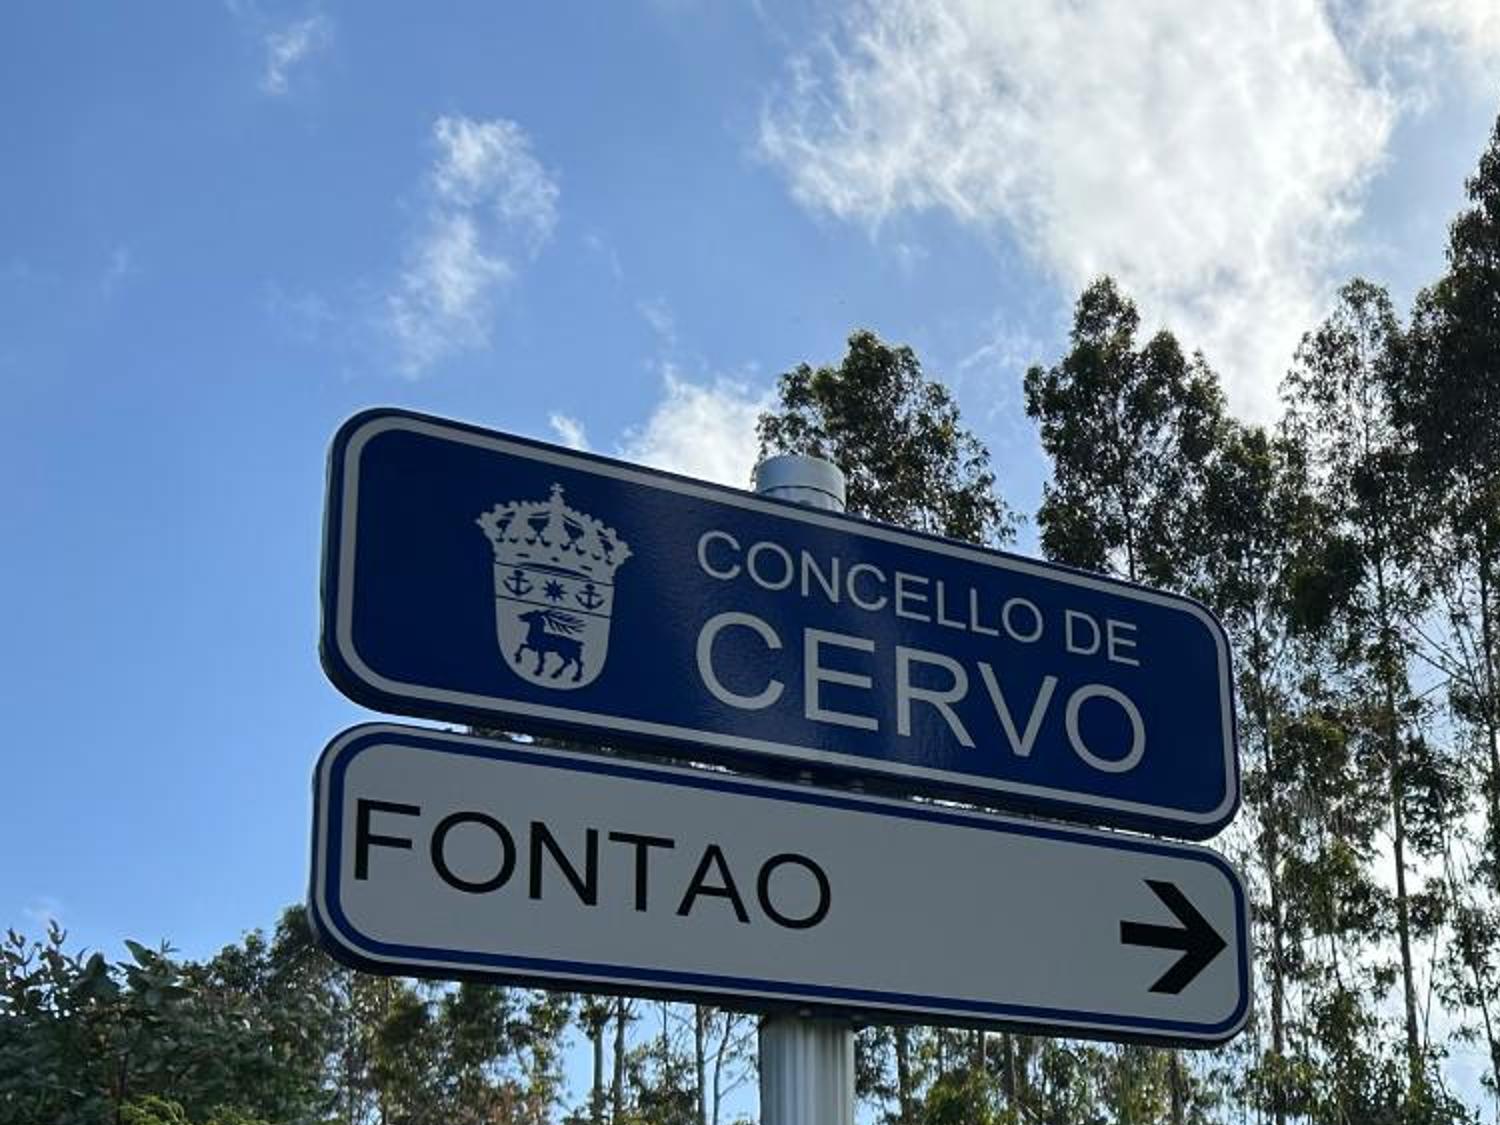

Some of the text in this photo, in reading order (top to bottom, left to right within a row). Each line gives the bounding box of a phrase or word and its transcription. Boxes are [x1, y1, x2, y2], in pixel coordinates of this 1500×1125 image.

[697, 530, 1140, 667] CONCELLO DE
[696, 611, 1147, 774] CERVO
[353, 797, 832, 930] FONTAO
